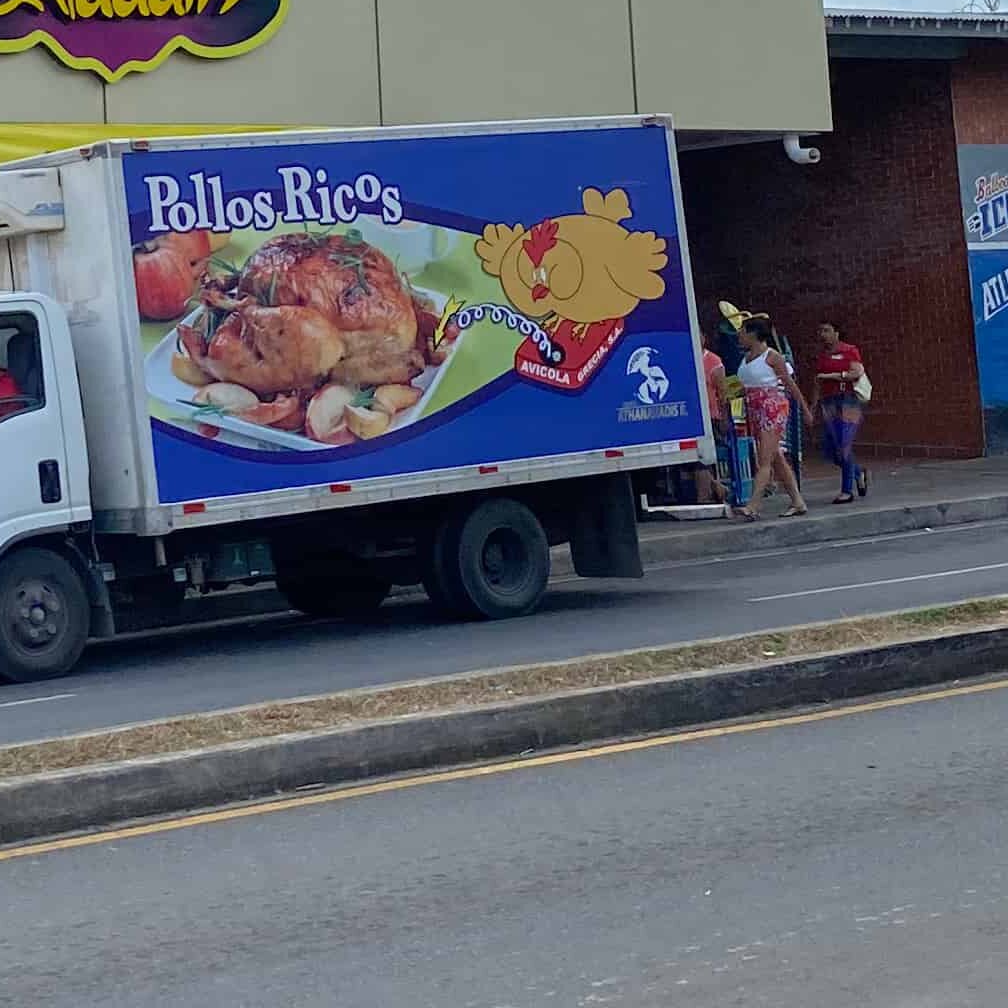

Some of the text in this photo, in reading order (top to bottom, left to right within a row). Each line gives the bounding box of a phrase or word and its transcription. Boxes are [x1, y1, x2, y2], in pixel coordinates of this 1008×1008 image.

[143, 165, 403, 233] Pollos Ricos
[520, 360, 570, 385] AVICOLA
